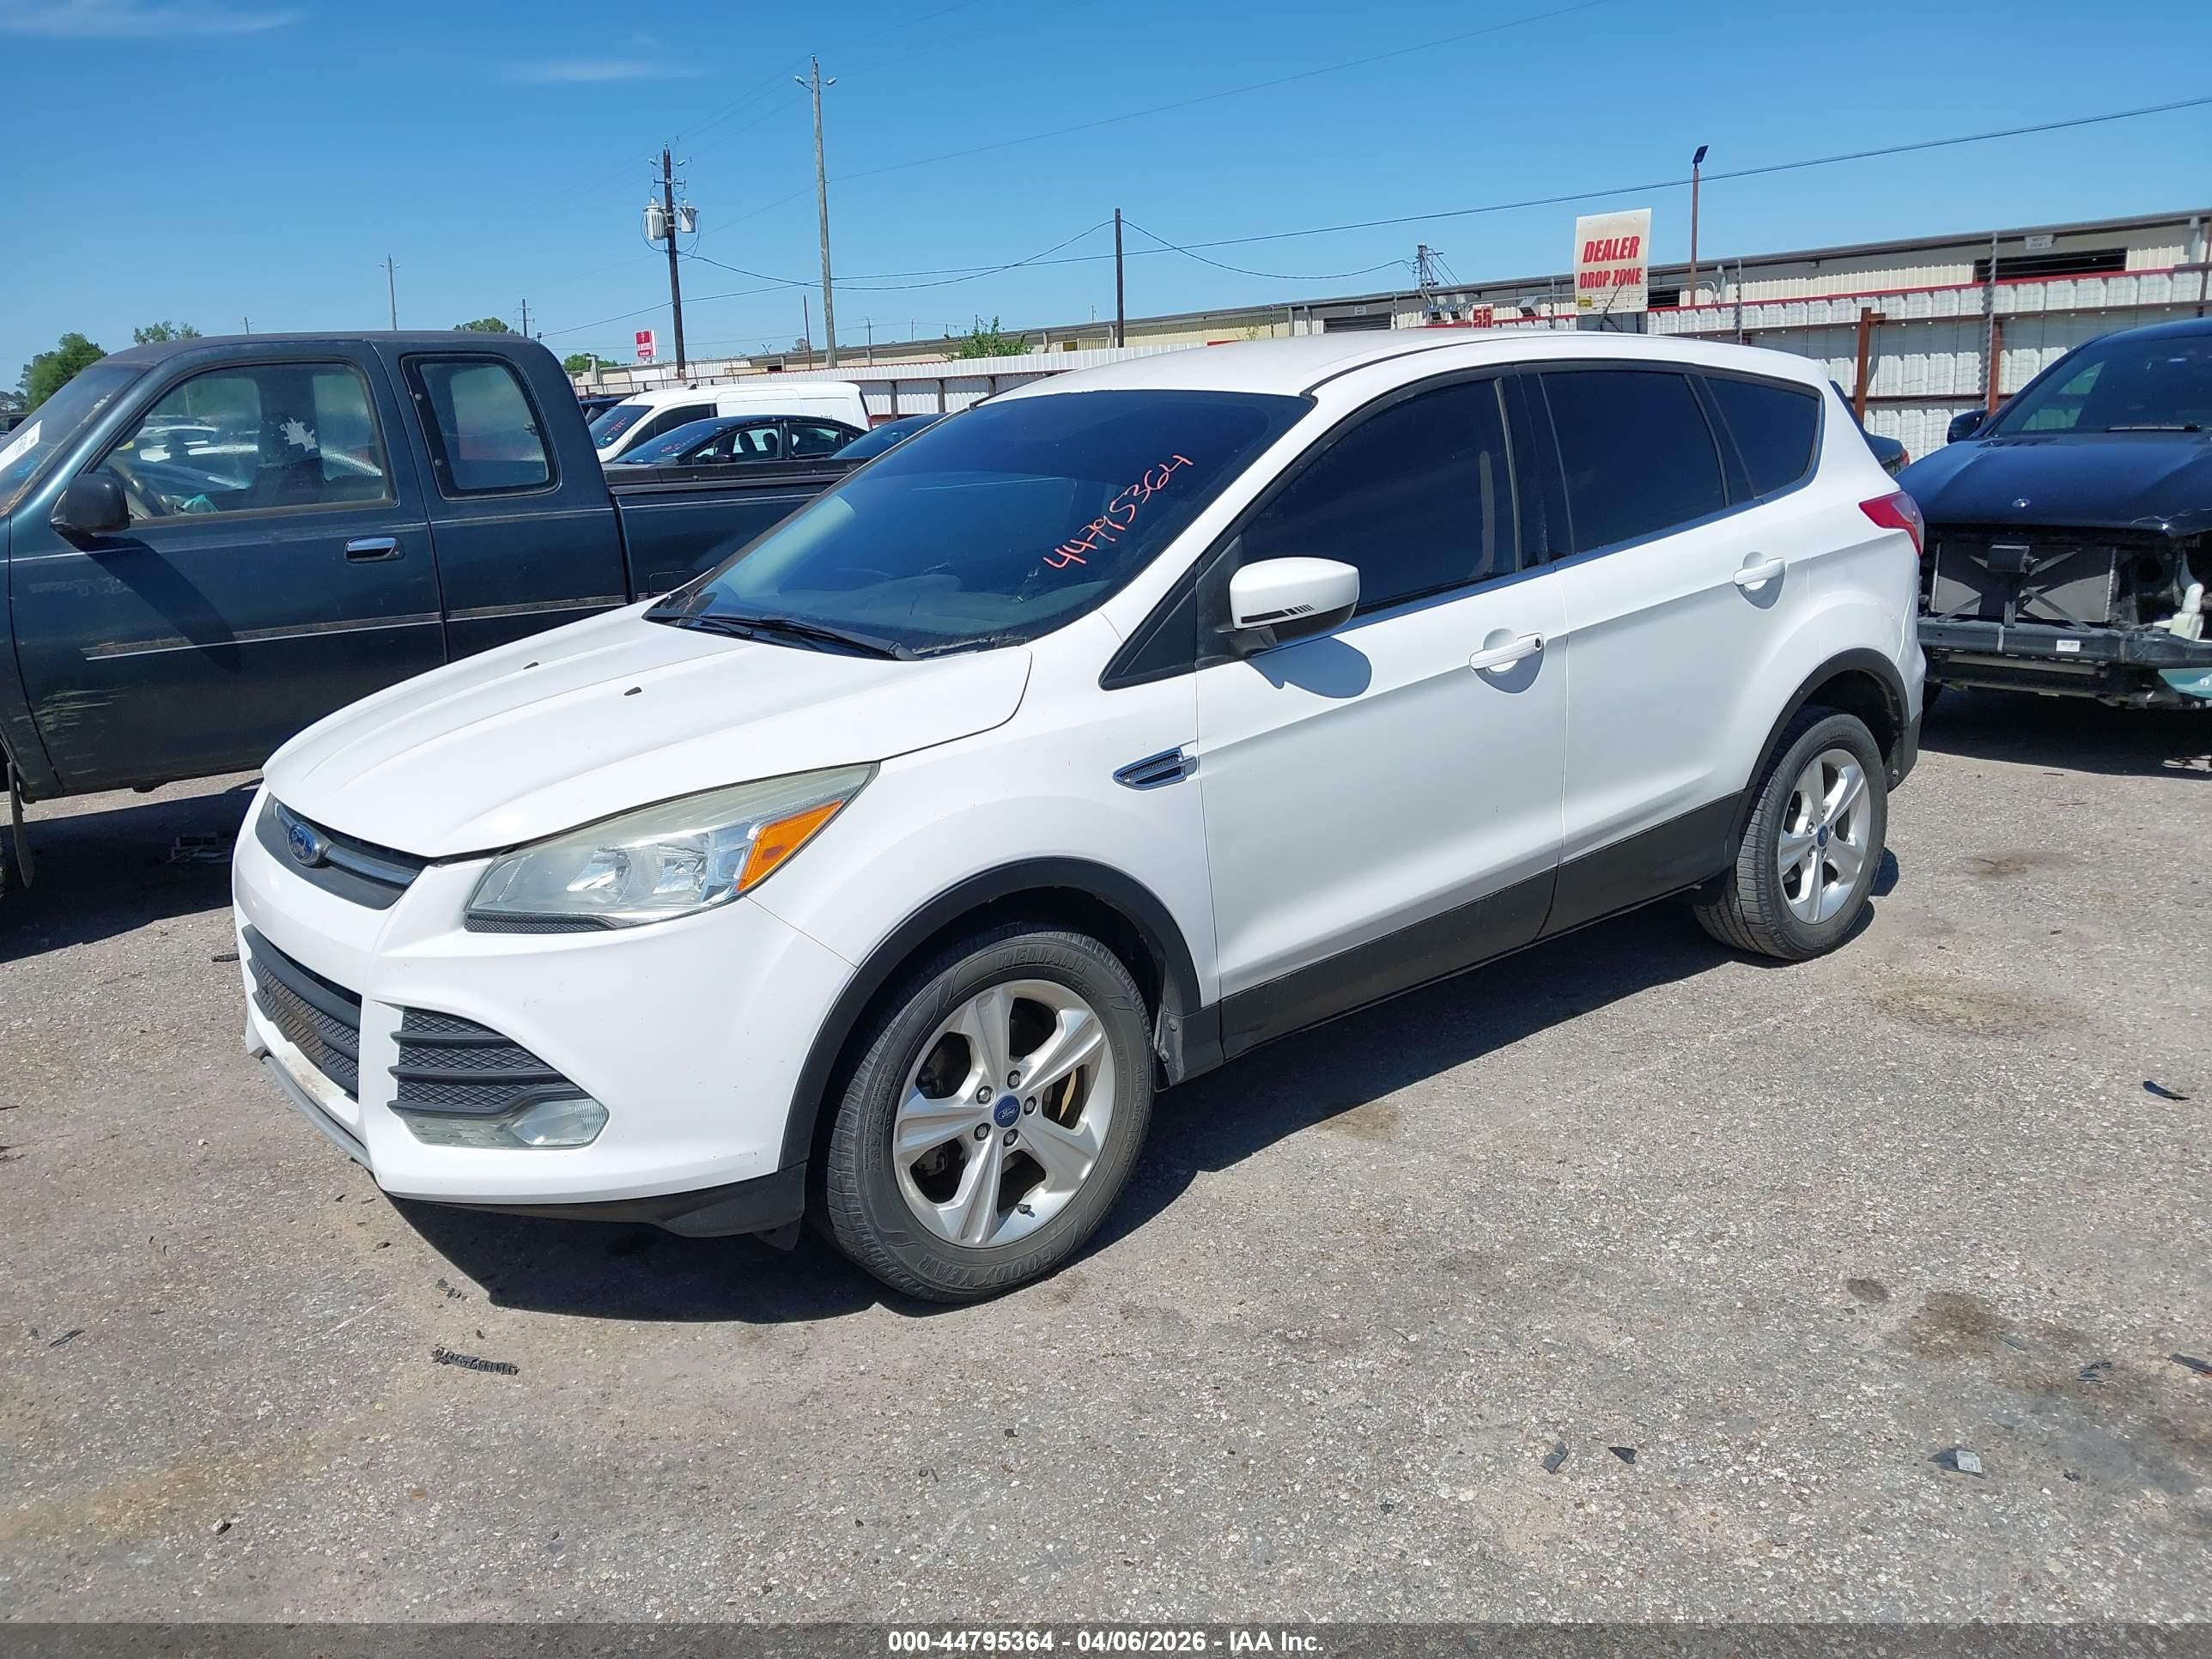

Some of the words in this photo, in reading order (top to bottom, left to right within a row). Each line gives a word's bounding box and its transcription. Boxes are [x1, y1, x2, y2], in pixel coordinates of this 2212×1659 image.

[1583, 236, 1640, 263] DEALER
[1580, 270, 1610, 289] DROP
[1612, 268, 1642, 286] ZONE
[1042, 454, 1194, 568] 44795364
